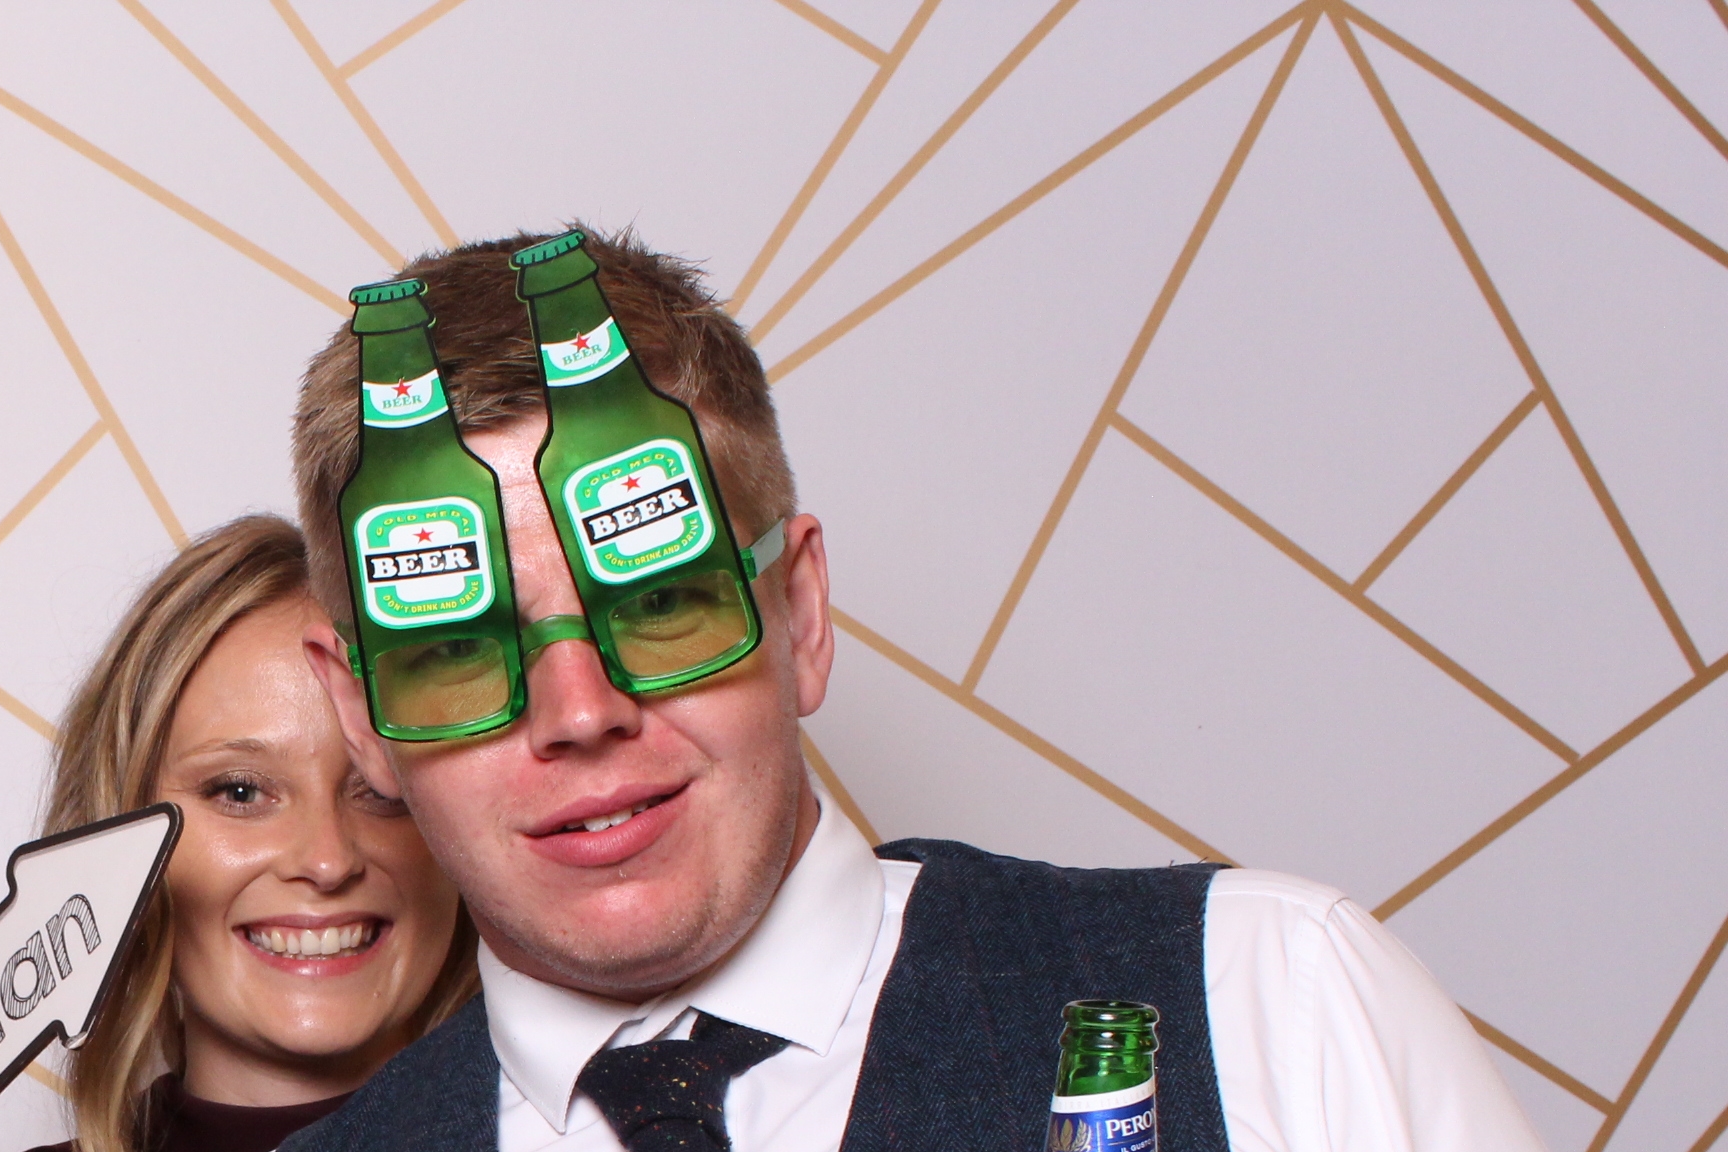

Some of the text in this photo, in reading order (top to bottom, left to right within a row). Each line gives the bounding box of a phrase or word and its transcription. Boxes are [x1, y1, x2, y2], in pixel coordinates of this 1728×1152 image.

[562, 344, 602, 366] BEER
[382, 395, 423, 409] BEER
[584, 453, 677, 498] GOLD MEDAL
[376, 510, 470, 536] GOLD MEDAL
[589, 488, 690, 540] BEER
[604, 519, 698, 567] DON'T DRINK AND DRIVE
[371, 548, 472, 579] BEER
[383, 581, 479, 613] DON'T DRINK AND DRIVE
[1105, 1108, 1154, 1139] PERO
